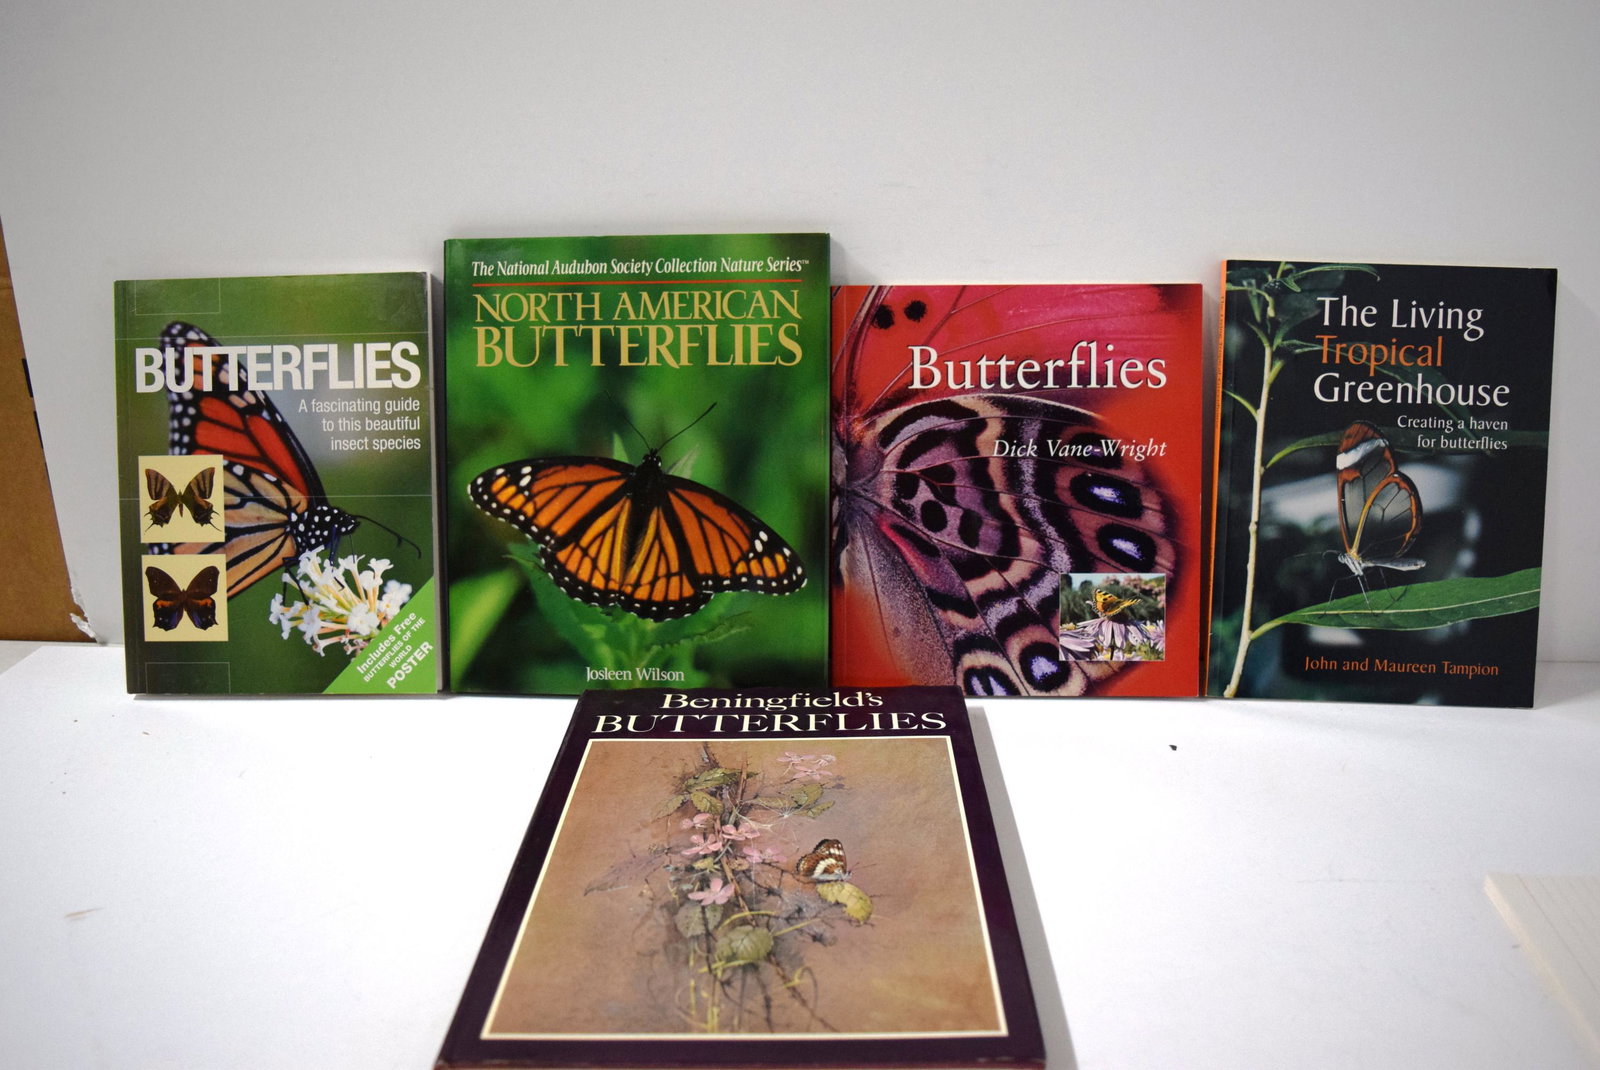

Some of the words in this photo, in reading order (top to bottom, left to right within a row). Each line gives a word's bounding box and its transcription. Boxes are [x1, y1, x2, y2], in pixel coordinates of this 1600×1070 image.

[472, 261, 495, 276] The
[497, 260, 550, 276] National
[551, 258, 608, 275] Audubon
[609, 258, 654, 277] Society
[655, 257, 718, 274] Collection
[720, 257, 764, 273] Nature
[473, 292, 601, 323] NORTH
[613, 289, 803, 322] AMERICAN
[1316, 295, 1378, 327] The
[1391, 298, 1485, 342] Living
[473, 323, 803, 369] BUTTERFLIES
[1315, 335, 1443, 378] Tropical
[135, 341, 422, 393] BUTTERFLIES
[908, 340, 1167, 390] Butterflies
[1313, 372, 1510, 407] Greenhouse
[298, 399, 309, 413] A
[311, 398, 381, 416] fascinating
[385, 397, 420, 415] guide
[322, 418, 336, 432] to
[338, 417, 362, 432] this
[365, 415, 421, 431] beautiful
[1397, 415, 1454, 431] Creating
[1457, 419, 1465, 429] a
[1469, 416, 1508, 431] haven
[331, 435, 370, 451] insect
[372, 435, 421, 454] species
[992, 438, 1038, 458] Dick
[1047, 438, 1167, 460] Vane-Wright
[1417, 435, 1437, 448] for
[1440, 435, 1508, 450] butterflies
[356, 634, 396, 674] Includes
[393, 612, 417, 635] Free
[363, 640, 404, 683] BUTTERFLIES
[402, 631, 412, 642] OF
[411, 617, 426, 632] THE
[386, 641, 434, 689] POSTER
[389, 644, 413, 669] WORLD
[1304, 655, 1338, 672] John
[1342, 657, 1369, 672] and
[1374, 658, 1437, 674] Maureen
[1442, 661, 1499, 680] Tampion
[585, 666, 632, 682] Josleen
[635, 667, 685, 682] Wilson
[591, 711, 948, 733] BUTTERFLIES
